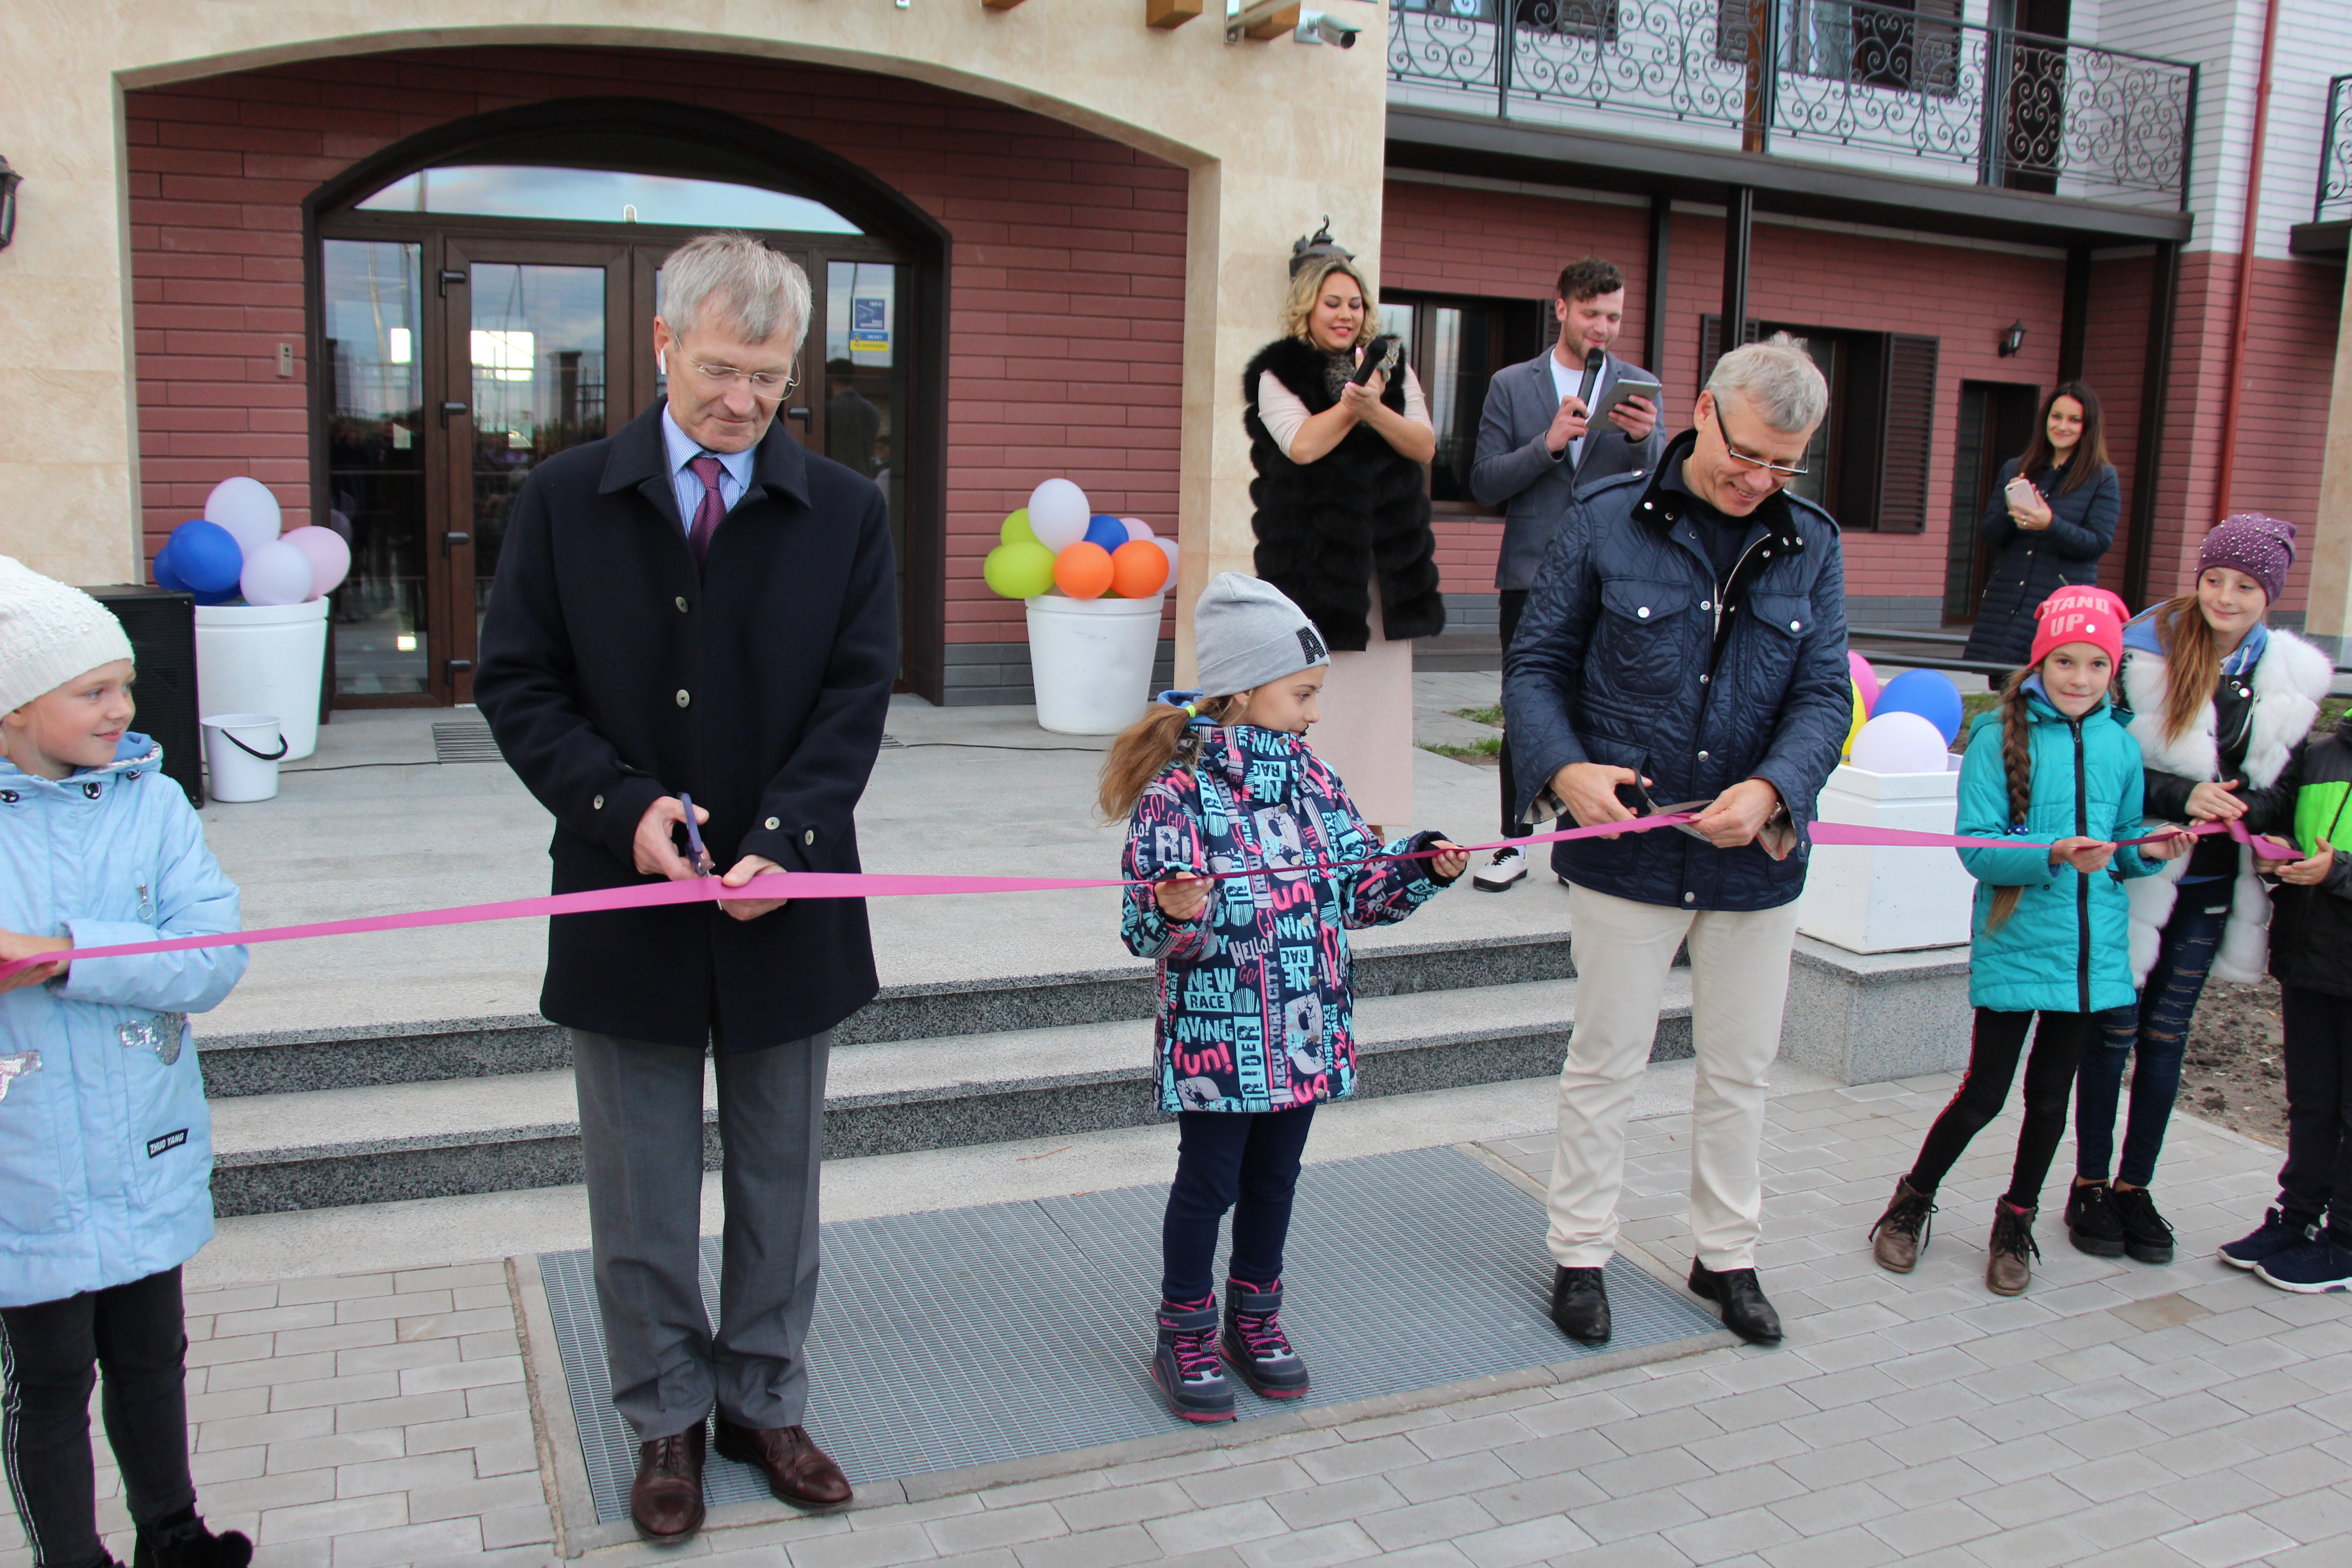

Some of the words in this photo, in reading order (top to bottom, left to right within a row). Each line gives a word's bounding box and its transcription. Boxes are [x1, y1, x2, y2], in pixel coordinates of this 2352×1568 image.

[2041, 596, 2110, 620] STAND
[2050, 613, 2085, 637] UP
[1228, 931, 1274, 967] HELLO!
[1187, 967, 1236, 993] NEW
[1239, 965, 1259, 985] GO!
[1264, 958, 1280, 1000] CITY
[1190, 994, 1225, 1009] RACE
[1269, 1001, 1282, 1046] YORK
[1322, 1004, 1334, 1076] EXPERIENCE
[1172, 1041, 1234, 1076] fun!
[1236, 1025, 1264, 1094] RIDER
[1271, 1048, 1286, 1088] NEW
[149, 1139, 167, 1155] ZHUO
[167, 1132, 185, 1147] YANG
